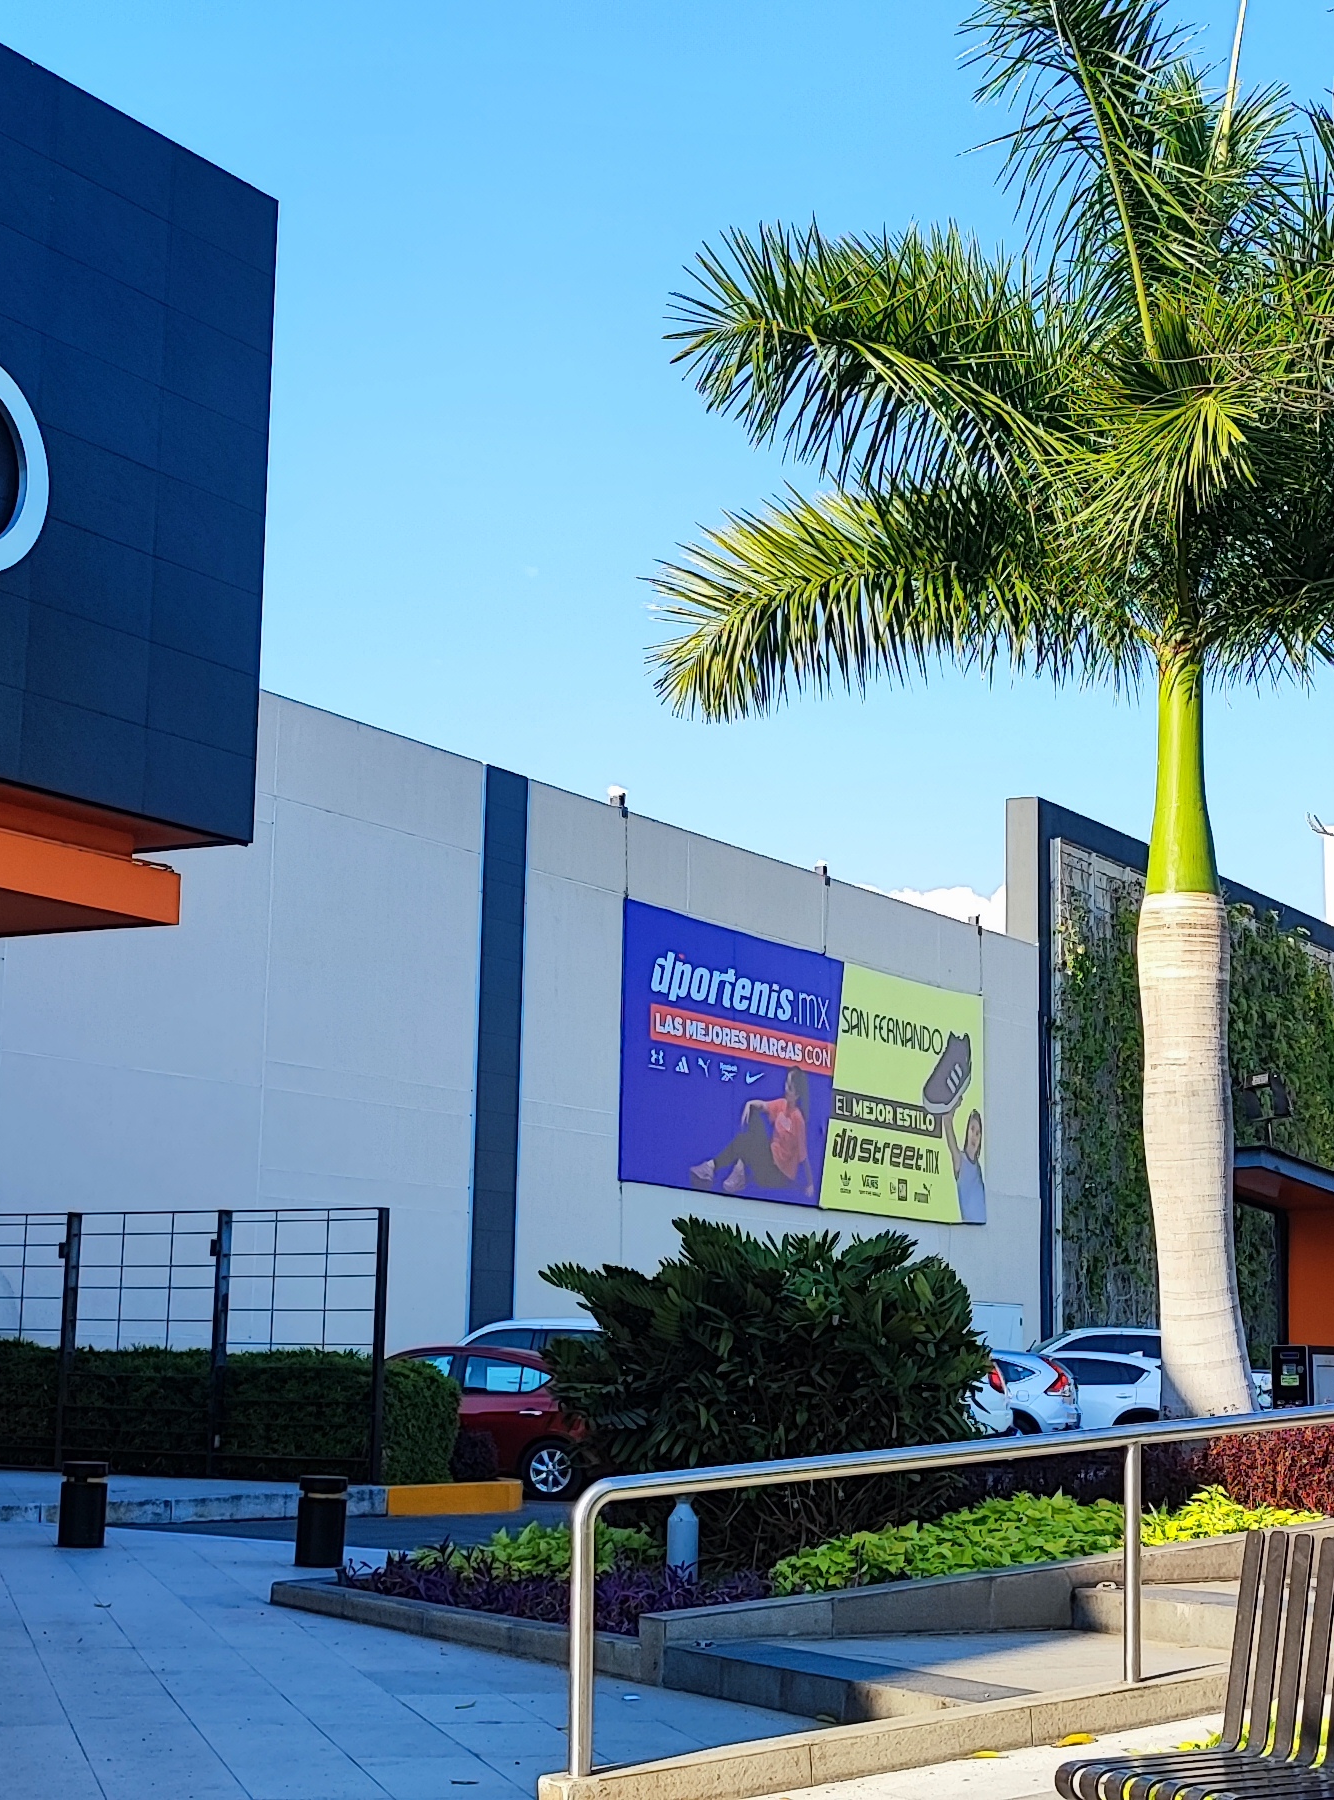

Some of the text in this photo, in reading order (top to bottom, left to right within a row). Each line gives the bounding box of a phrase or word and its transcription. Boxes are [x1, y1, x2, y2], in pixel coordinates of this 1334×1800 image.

[655, 1012, 831, 1068] LAS MEJORES MARCAS CON
[841, 1006, 943, 1055] SAN FERNANDO
[835, 1095, 935, 1132] EL MEJOR ESTILO
